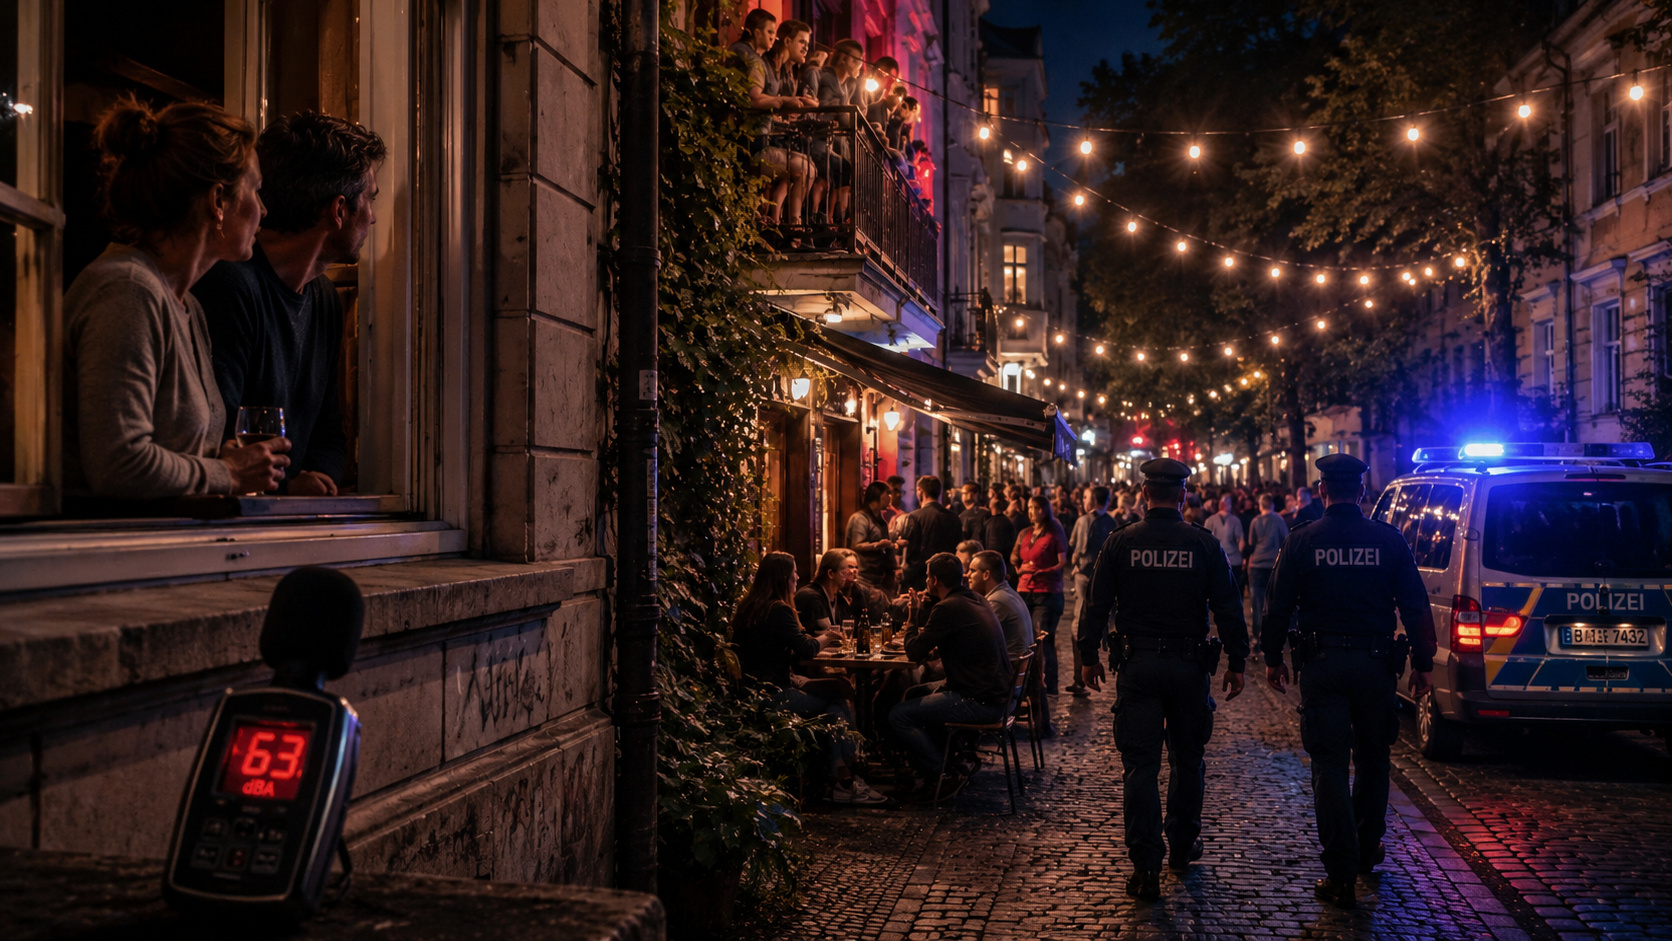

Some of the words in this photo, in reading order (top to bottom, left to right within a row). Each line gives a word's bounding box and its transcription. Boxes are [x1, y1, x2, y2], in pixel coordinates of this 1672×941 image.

[1131, 549, 1193, 568] POLIZEI
[1315, 548, 1380, 566] POLIZEI
[1567, 592, 1644, 611] POLIZEI
[1613, 630, 1646, 644] 7432
[241, 731, 305, 780] 63
[242, 779, 275, 797] dBA
